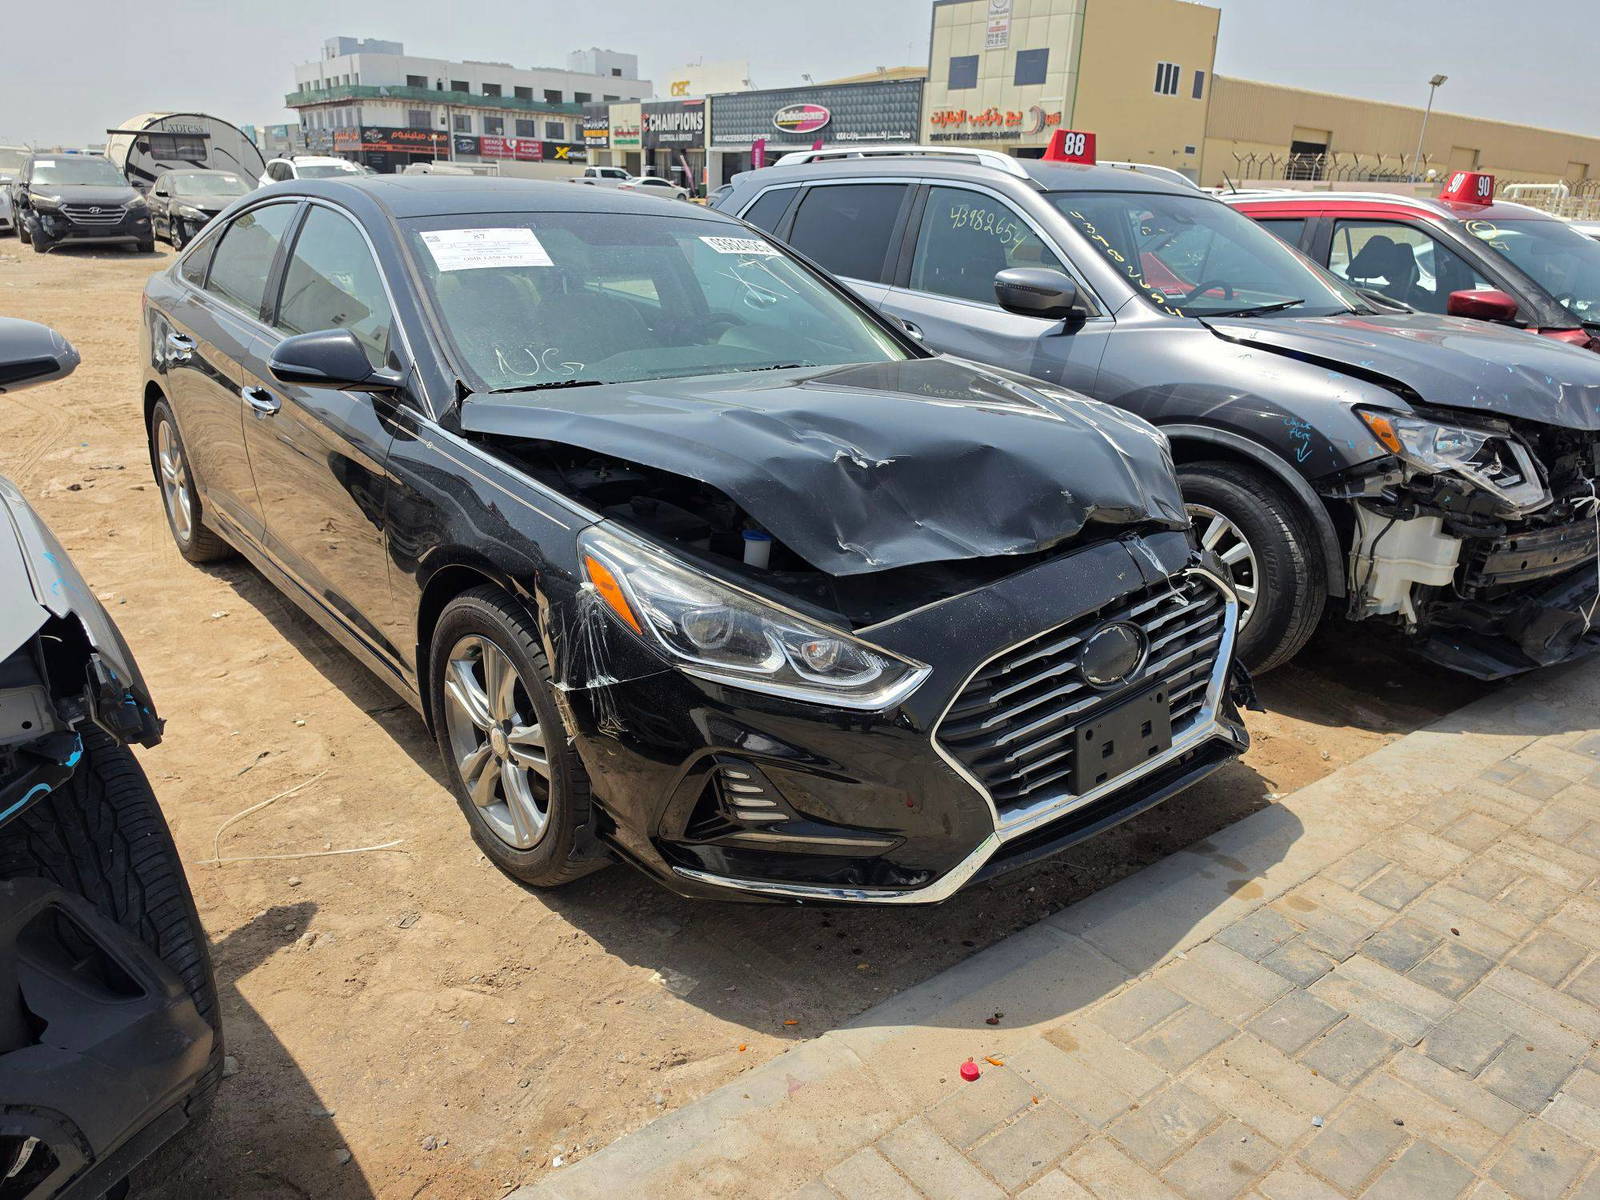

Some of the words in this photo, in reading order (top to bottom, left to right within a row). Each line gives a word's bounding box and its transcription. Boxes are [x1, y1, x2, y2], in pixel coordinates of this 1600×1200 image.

[650, 112, 703, 131] CHAMPIONS
[1064, 132, 1085, 156] 88
[1448, 173, 1465, 193] 90
[1477, 176, 1490, 197] 90
[950, 207, 1027, 255] 43982654
